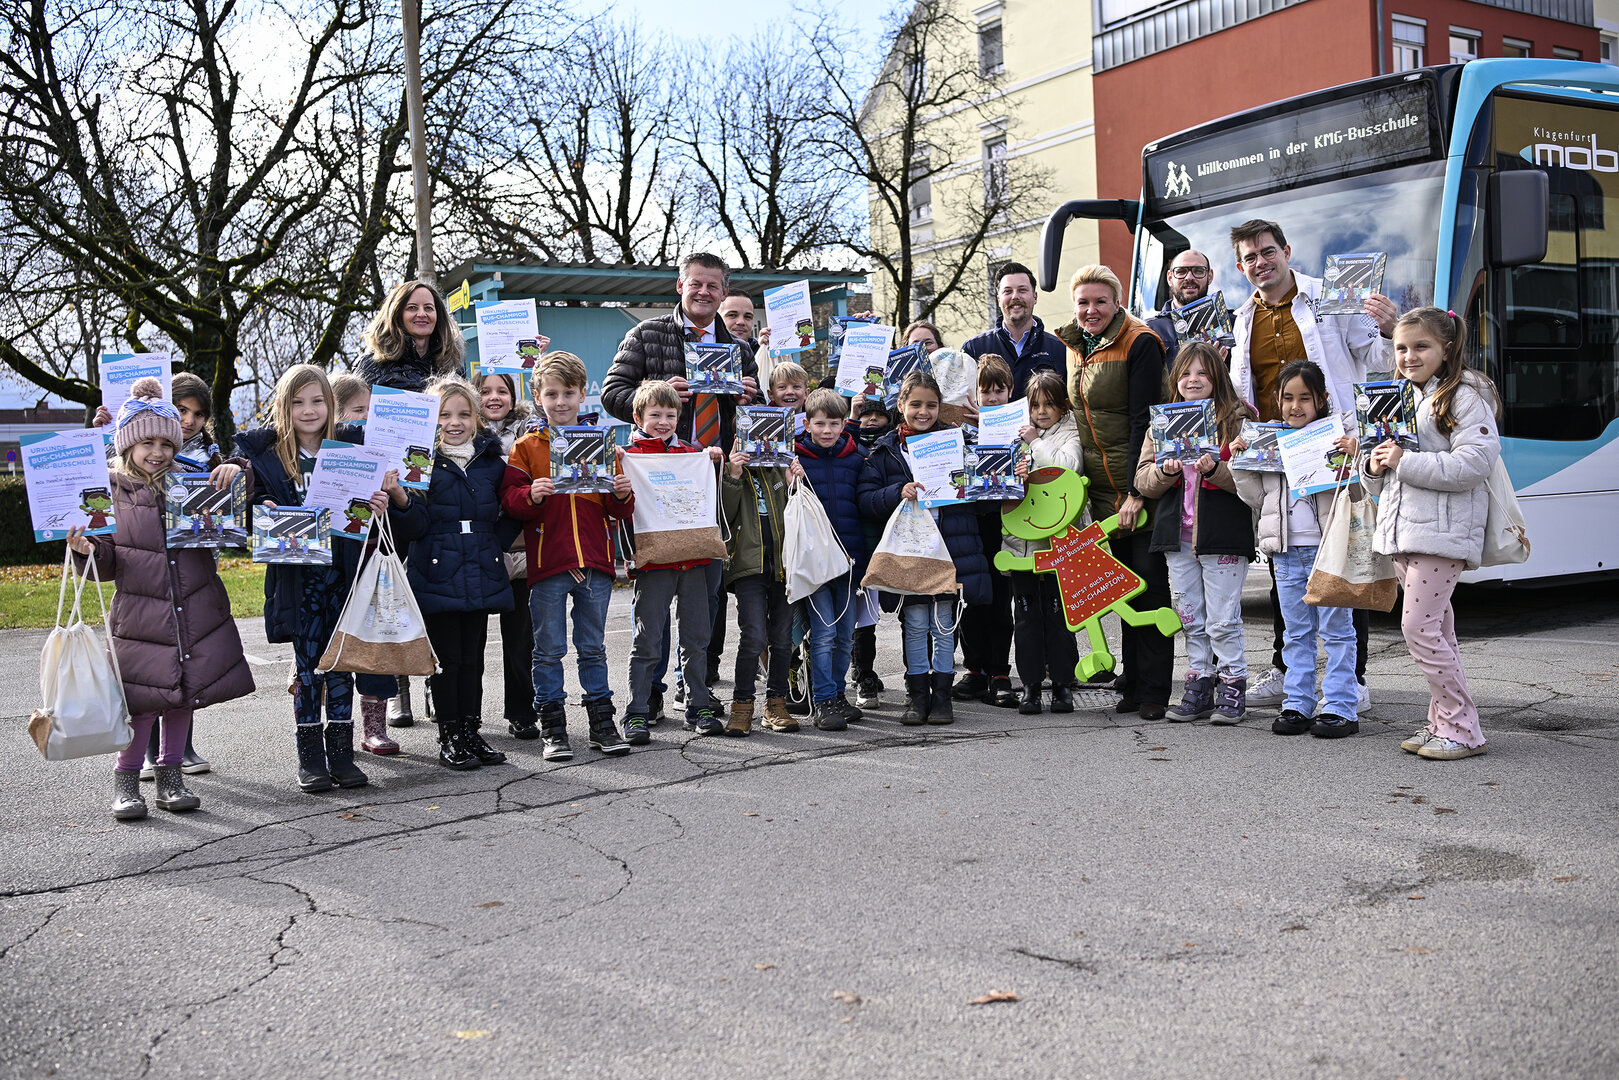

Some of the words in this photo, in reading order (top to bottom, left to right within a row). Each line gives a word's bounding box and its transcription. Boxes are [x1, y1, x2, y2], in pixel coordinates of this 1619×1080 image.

[1533, 127, 1591, 143] Klagenfurt
[1197, 153, 1264, 177] Willkommen
[1269, 147, 1281, 160] in
[1286, 141, 1308, 156] der
[1314, 113, 1419, 149] KMG-Busschule
[482, 311, 527, 320] BUS-CHAMPION
[109, 368, 160, 380] BUS-CHAMPION
[378, 399, 408, 407] URKUNDE
[376, 407, 427, 416] BUS-CHAMPION
[376, 414, 428, 426] KMG-BUSSCHULE
[30, 445, 66, 454] URKUNDE
[31, 446, 92, 463] BUS-CHAMPION
[914, 442, 956, 456] BUS-CHAMPION
[326, 452, 357, 460] URKUNDE
[34, 459, 96, 470] KMG-BUSSCHULE
[323, 460, 376, 469] BUS-CHAMPION
[322, 467, 375, 480] KMG-BUSSCHULE
[1057, 544, 1068, 554] Mit
[1069, 538, 1079, 546] der
[1050, 538, 1094, 567] KMG-Busschule
[1070, 573, 1126, 611] BUS-CHAMPION!
[1072, 586, 1088, 599] wirst
[1089, 576, 1104, 588] auch
